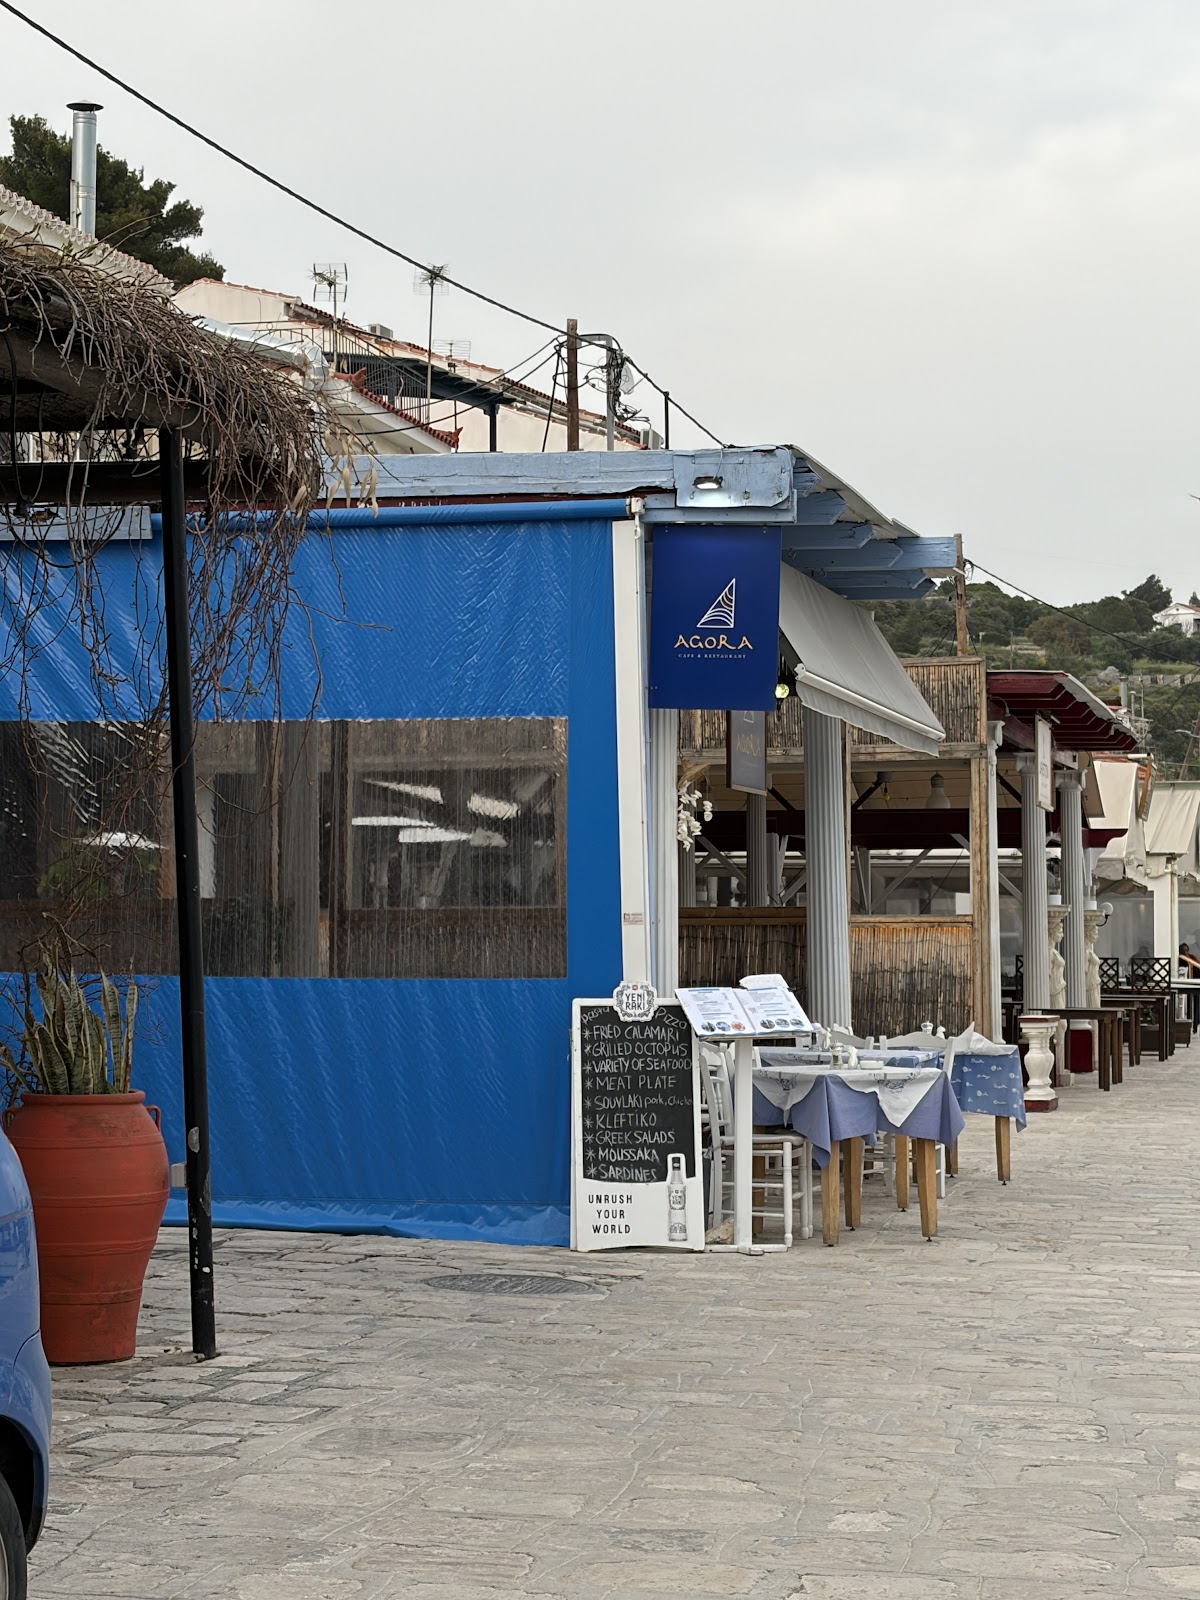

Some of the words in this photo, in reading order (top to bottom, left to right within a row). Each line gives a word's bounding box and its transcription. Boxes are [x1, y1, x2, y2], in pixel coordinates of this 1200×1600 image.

[674, 634, 753, 650] AGORA
[593, 1024, 621, 1038] FRIED
[624, 1025, 679, 1042] CALAMARI
[593, 1057, 630, 1073] VARIETY
[631, 1058, 646, 1071] OF
[646, 1058, 692, 1072] SEAFOOD
[596, 1075, 632, 1091] MEAT
[638, 1075, 676, 1090] PLATE
[594, 1093, 643, 1110] SOUVLAKI
[595, 1130, 633, 1146] GREEK
[633, 1130, 676, 1145] SALADS
[598, 1147, 661, 1163] MOUSSAKA
[588, 1194, 633, 1204] UNRUSH
[596, 1209, 625, 1219] YOUR
[592, 1224, 631, 1234] WORLD
